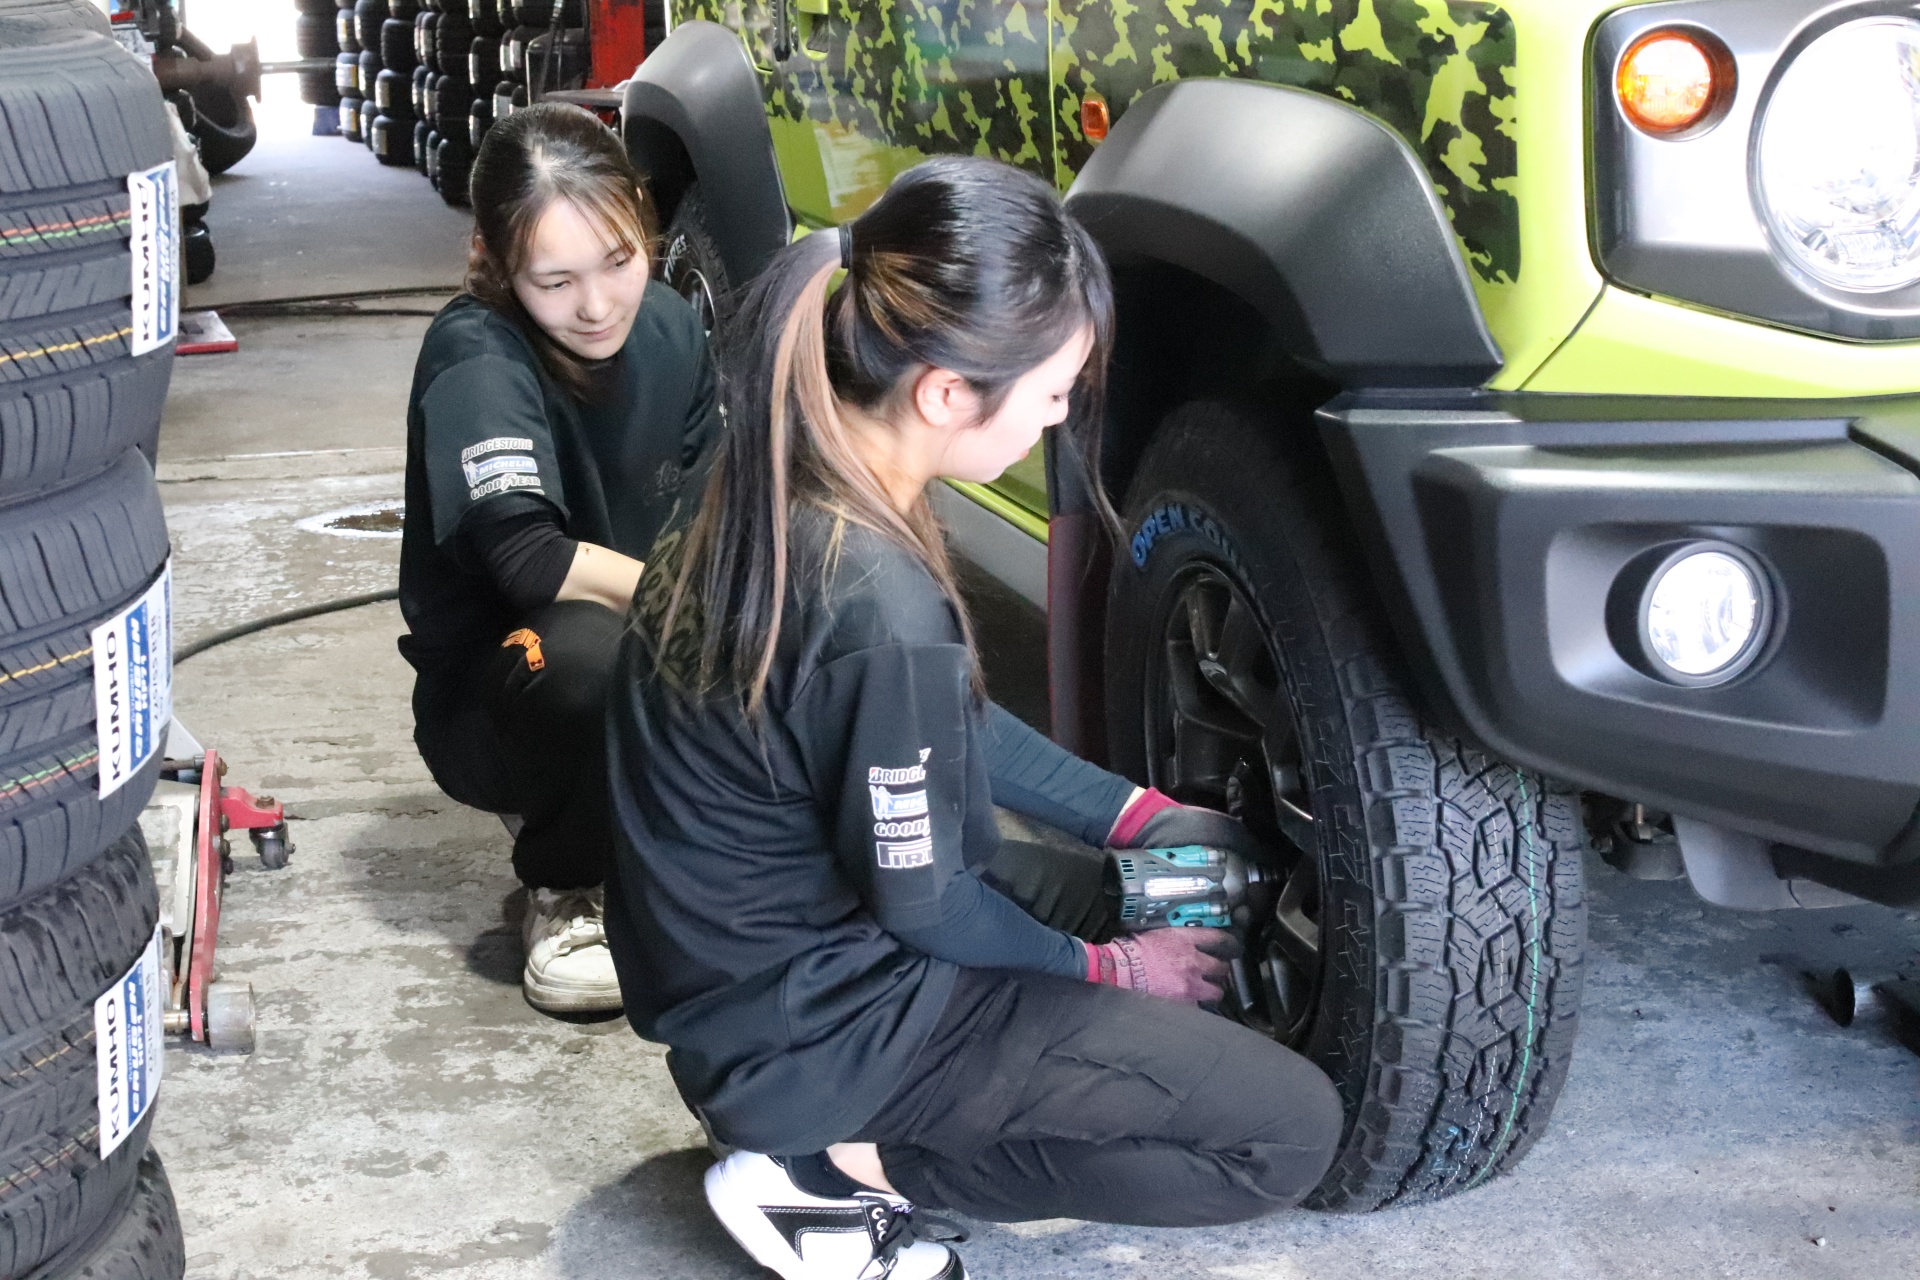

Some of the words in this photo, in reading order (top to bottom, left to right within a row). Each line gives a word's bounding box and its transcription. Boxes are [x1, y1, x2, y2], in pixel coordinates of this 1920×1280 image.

[137, 183, 150, 341] KUMHO
[664, 234, 687, 284] TIRES
[462, 439, 532, 462] BRIDGESTONE
[479, 459, 533, 475] MICHELIN
[1131, 503, 1188, 568] OPEN
[107, 631, 121, 781] KUMHO
[107, 998, 120, 1140] KUMHO
